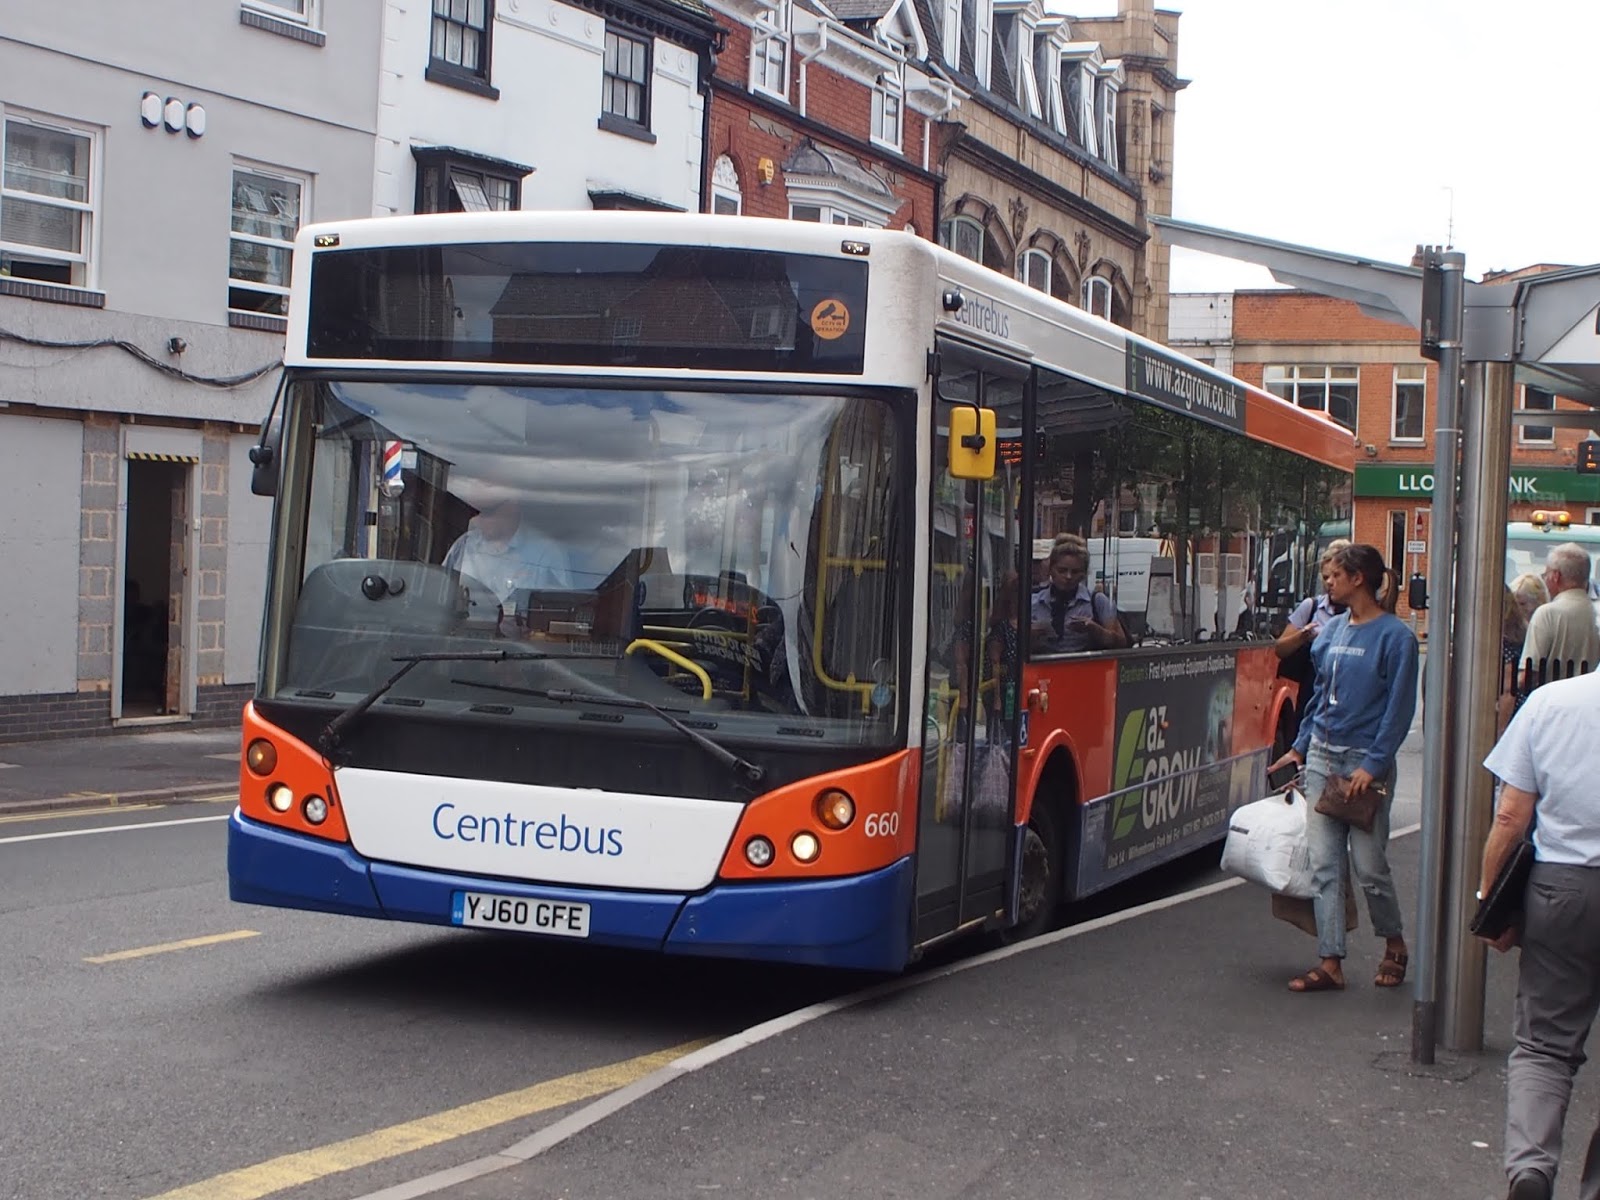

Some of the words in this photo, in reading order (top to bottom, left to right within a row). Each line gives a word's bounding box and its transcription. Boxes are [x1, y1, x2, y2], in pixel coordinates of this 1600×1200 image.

[1144, 355, 1238, 420] www.azgrow.co.uk
[1399, 474, 1435, 491] LLO
[1509, 476, 1538, 494] NK
[1142, 746, 1200, 830] GROW
[432, 802, 623, 857] Centrebus
[864, 811, 899, 838] 660
[467, 896, 528, 925] YJ60
[535, 903, 583, 931] GFE
